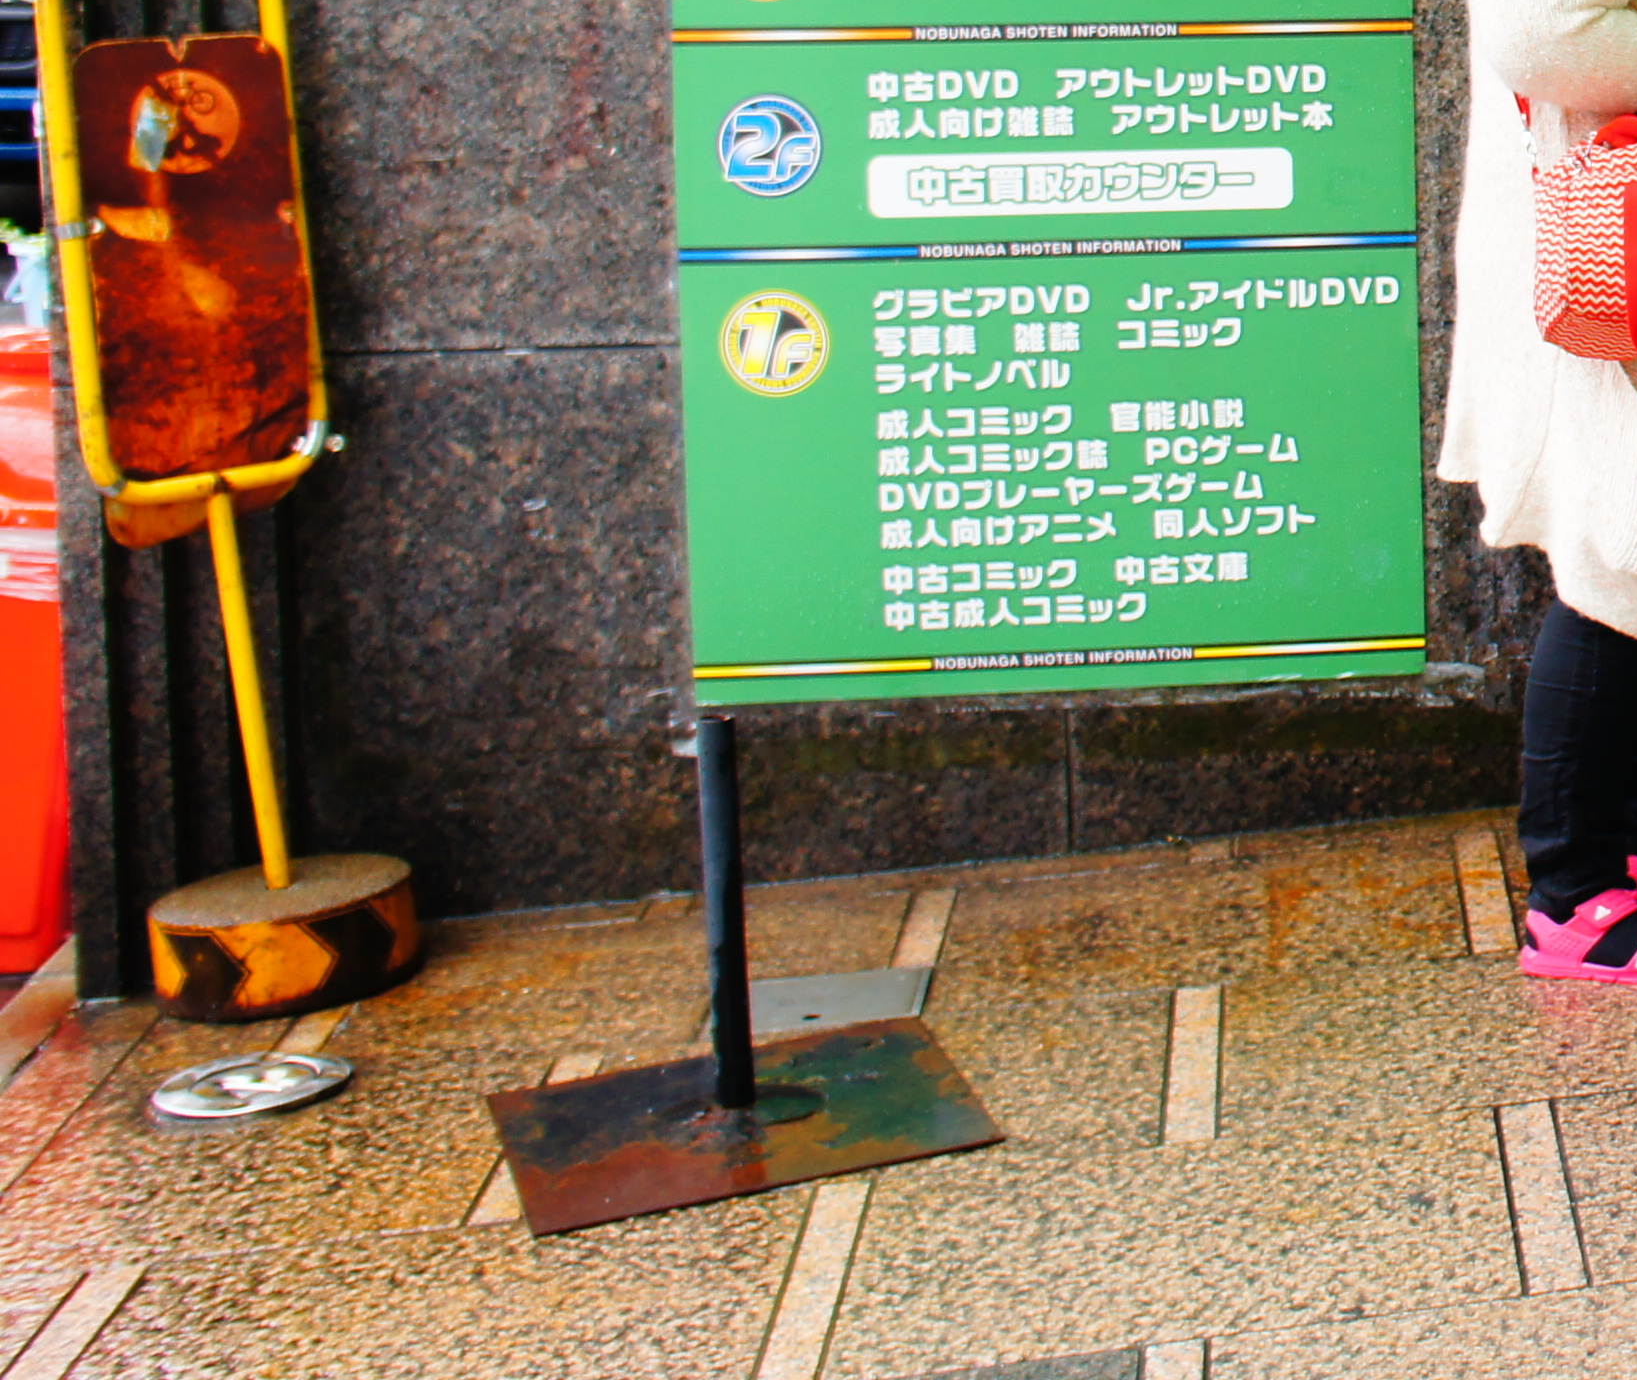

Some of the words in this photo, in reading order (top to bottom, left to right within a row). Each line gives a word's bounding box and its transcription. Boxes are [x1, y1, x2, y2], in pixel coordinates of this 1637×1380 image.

[915, 26, 1001, 40] NOBUNAGA
[1005, 25, 1069, 40] SHOTEN
[1072, 24, 1178, 39] INFORMATION
[868, 70, 1020, 102] 中古DVD
[1055, 65, 1328, 100] アウトレットDVD
[868, 106, 1074, 140] 成人向け雑誌
[1110, 101, 1334, 137] アウトレット本
[725, 112, 816, 183] 2F
[907, 165, 1256, 206] 中古買取カウンター
[920, 244, 1006, 259] NOBUNAGA
[1010, 242, 1074, 257] SHOTEN
[1077, 240, 1182, 255] INFORMATION
[873, 285, 1092, 322] グラビアDVD
[1128, 276, 1401, 314] Jr.アイドルDVD
[740, 310, 814, 380] 1F
[874, 323, 976, 357] 写真集
[1014, 321, 1081, 355] 雑誌
[1117, 319, 1243, 352] コミック
[874, 357, 1071, 394] ライトノベル
[877, 404, 1074, 440] 成人コミック
[1110, 399, 1246, 433] 官能小説
[879, 440, 1110, 477] 成人コミック誌
[1146, 434, 1300, 468] PCゲーム
[880, 472, 1265, 513] DVDプレーヤーズゲーム
[881, 513, 1118, 550] 成人向けアニメ
[1154, 506, 1317, 541] 同人ソフト
[883, 560, 1078, 596] 中古コミック
[1115, 551, 1250, 587] 中古文庫
[884, 594, 1148, 632] 中古成人コミック
[934, 655, 1020, 671] NOBUNAGA
[1023, 653, 1086, 669] SHOTEN
[1089, 648, 1194, 666] INFORMATION
